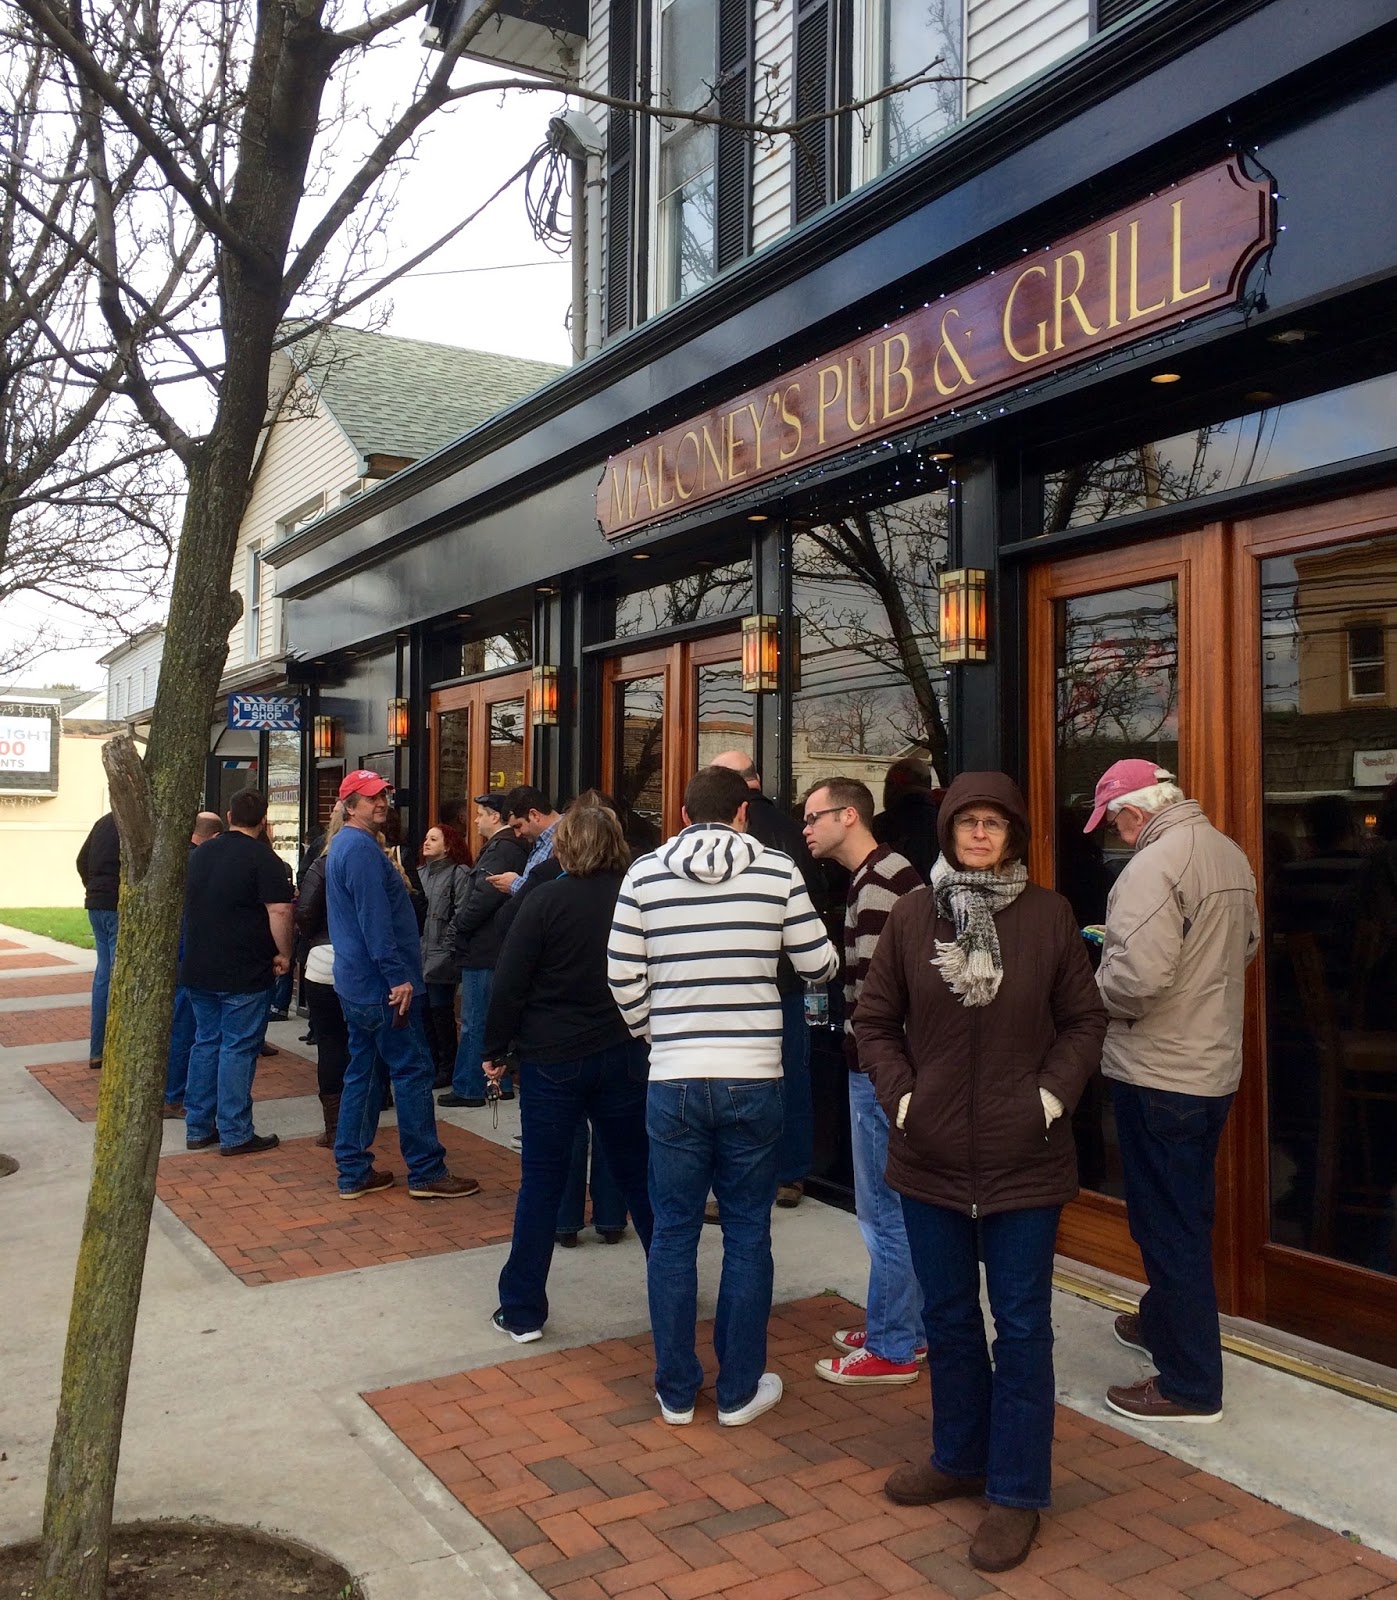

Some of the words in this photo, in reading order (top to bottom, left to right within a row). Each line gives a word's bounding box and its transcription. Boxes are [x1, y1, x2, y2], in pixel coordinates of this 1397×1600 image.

[608, 383, 802, 528] MALONEY'S
[817, 332, 914, 446] PUB
[933, 308, 979, 396] &
[1003, 199, 1212, 363] GRILL
[243, 703, 290, 713] BARBER
[251, 711, 283, 720] SHOP
